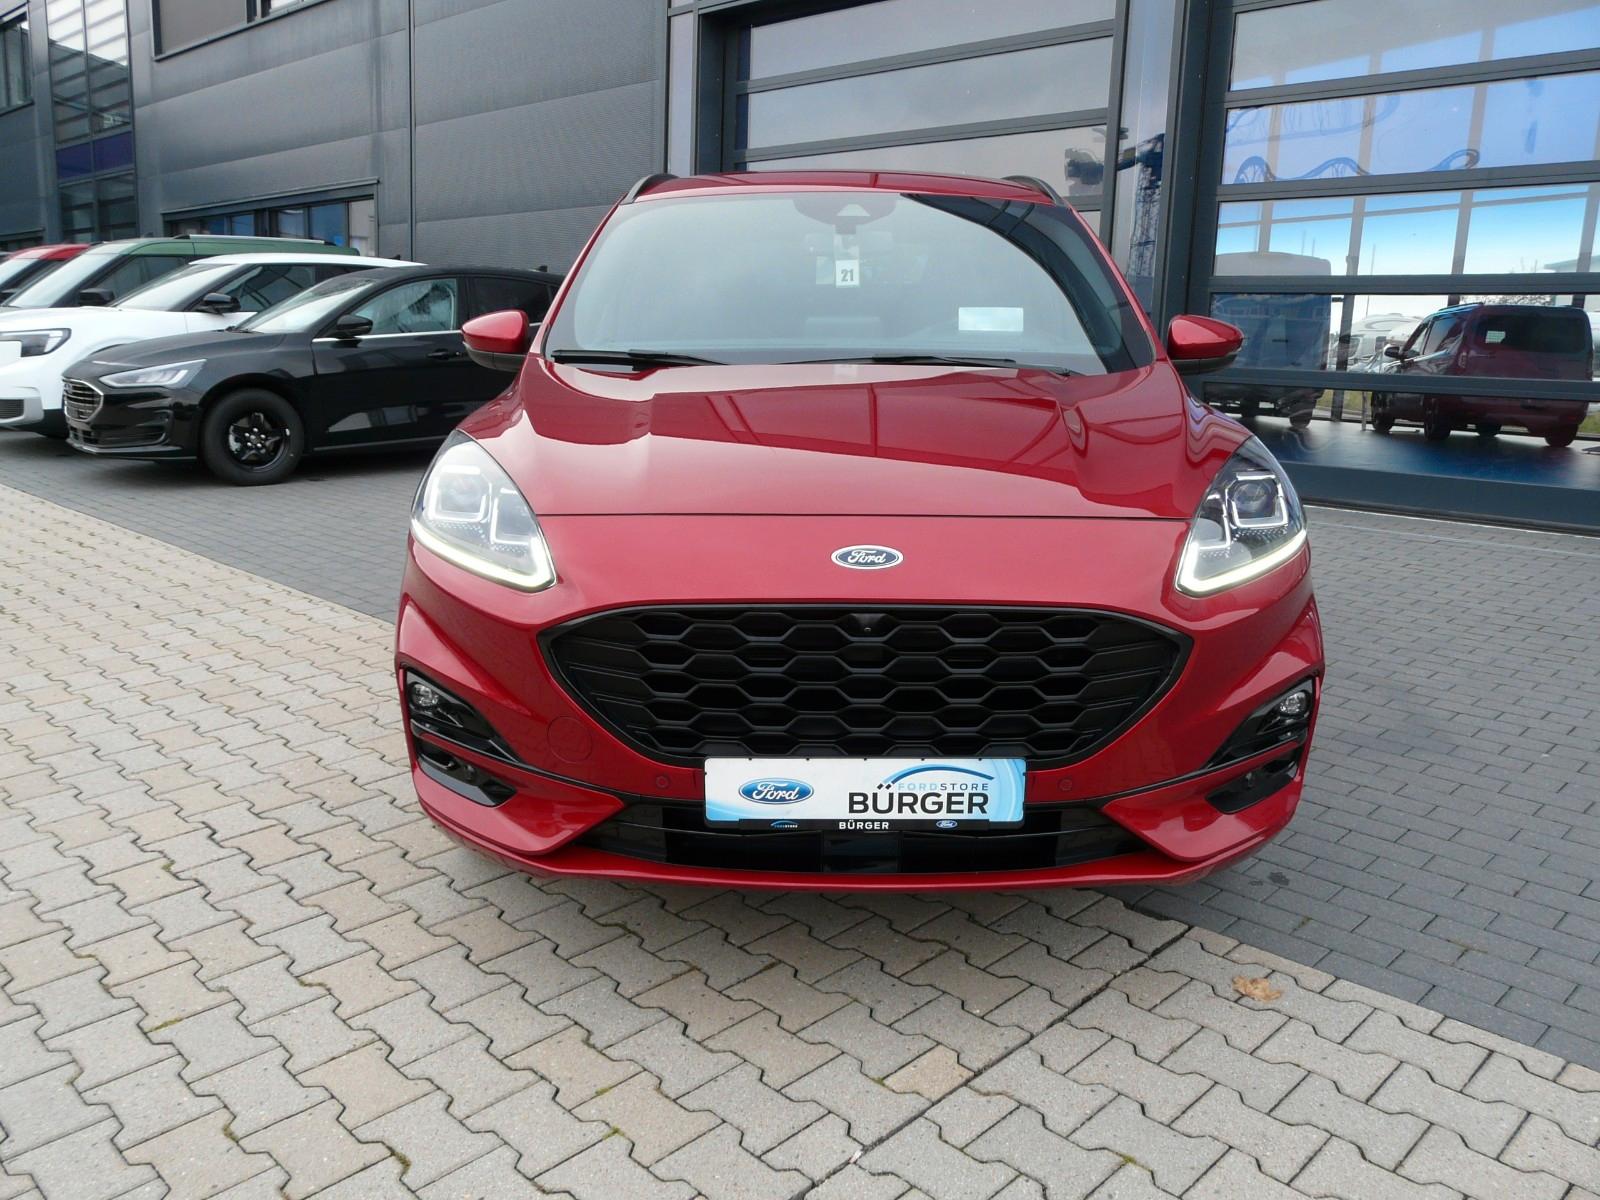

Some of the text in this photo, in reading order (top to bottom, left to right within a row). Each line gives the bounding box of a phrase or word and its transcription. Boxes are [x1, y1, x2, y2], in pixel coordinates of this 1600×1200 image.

[841, 268, 854, 282] 21
[847, 549, 887, 564] Ford
[752, 782, 800, 800] Ford
[898, 783, 989, 791] FORDSTORE
[848, 783, 989, 814] BÜRGER
[839, 819, 889, 830] BÜRGER
